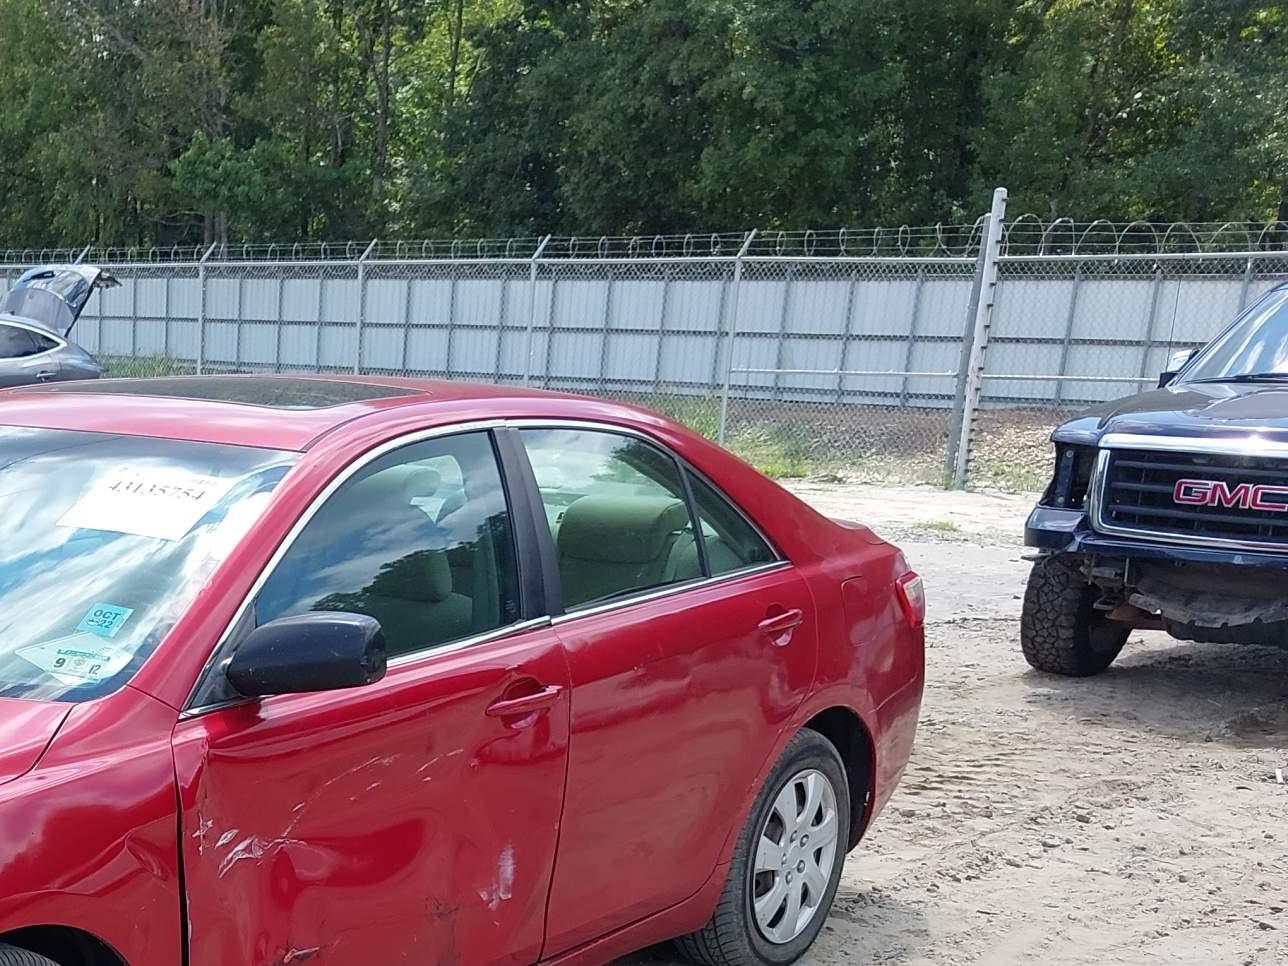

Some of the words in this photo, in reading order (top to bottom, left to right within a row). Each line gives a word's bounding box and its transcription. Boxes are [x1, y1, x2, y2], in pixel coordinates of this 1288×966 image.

[1174, 479, 1288, 512] GMC
[93, 609, 121, 620] OCT
[53, 657, 66, 669] 9
